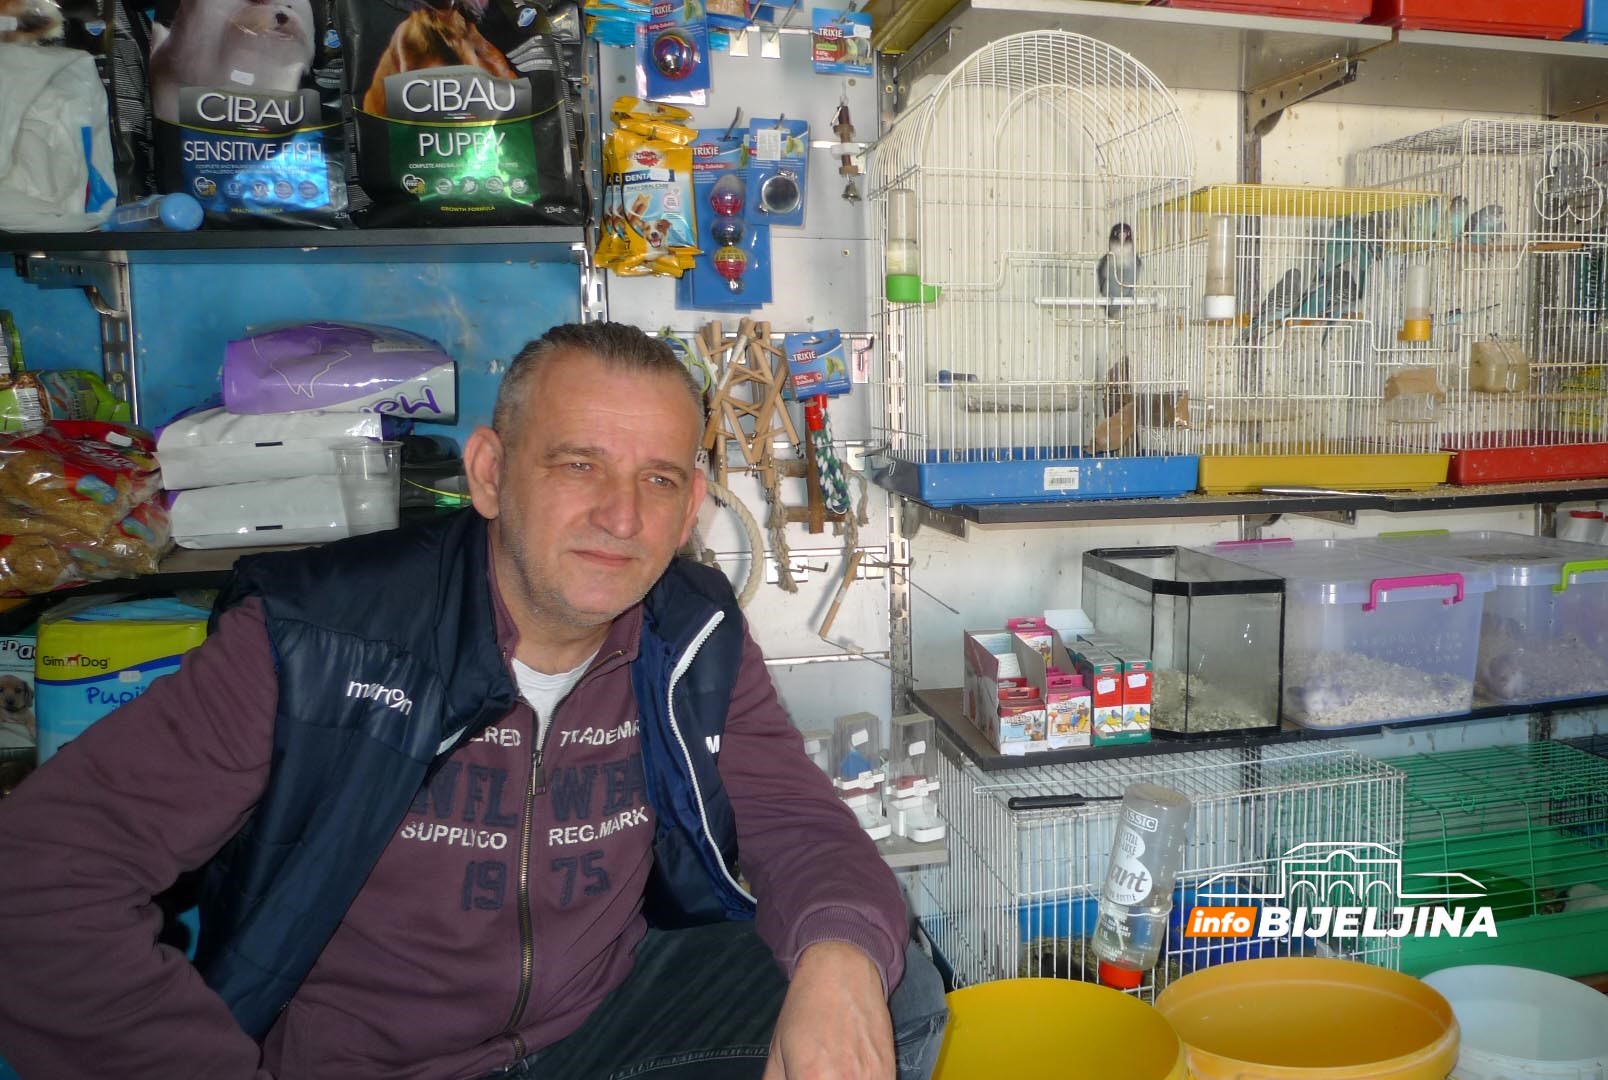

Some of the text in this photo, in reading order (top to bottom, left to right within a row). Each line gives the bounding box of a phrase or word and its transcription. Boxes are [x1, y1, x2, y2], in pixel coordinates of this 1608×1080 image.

[652, 4, 673, 16] TRIXIE
[819, 28, 843, 38] TRIXIE
[402, 77, 516, 113] CIBAU
[197, 91, 305, 125] CIBAU
[183, 140, 323, 162] SENSITIVE FISH
[418, 130, 506, 157] PUPPY
[693, 146, 720, 156] TRIXIE
[792, 351, 817, 361] TRIXIE
[470, 725, 521, 747] RED
[462, 849, 611, 912] 19 75
[1111, 864, 1149, 893] ant
